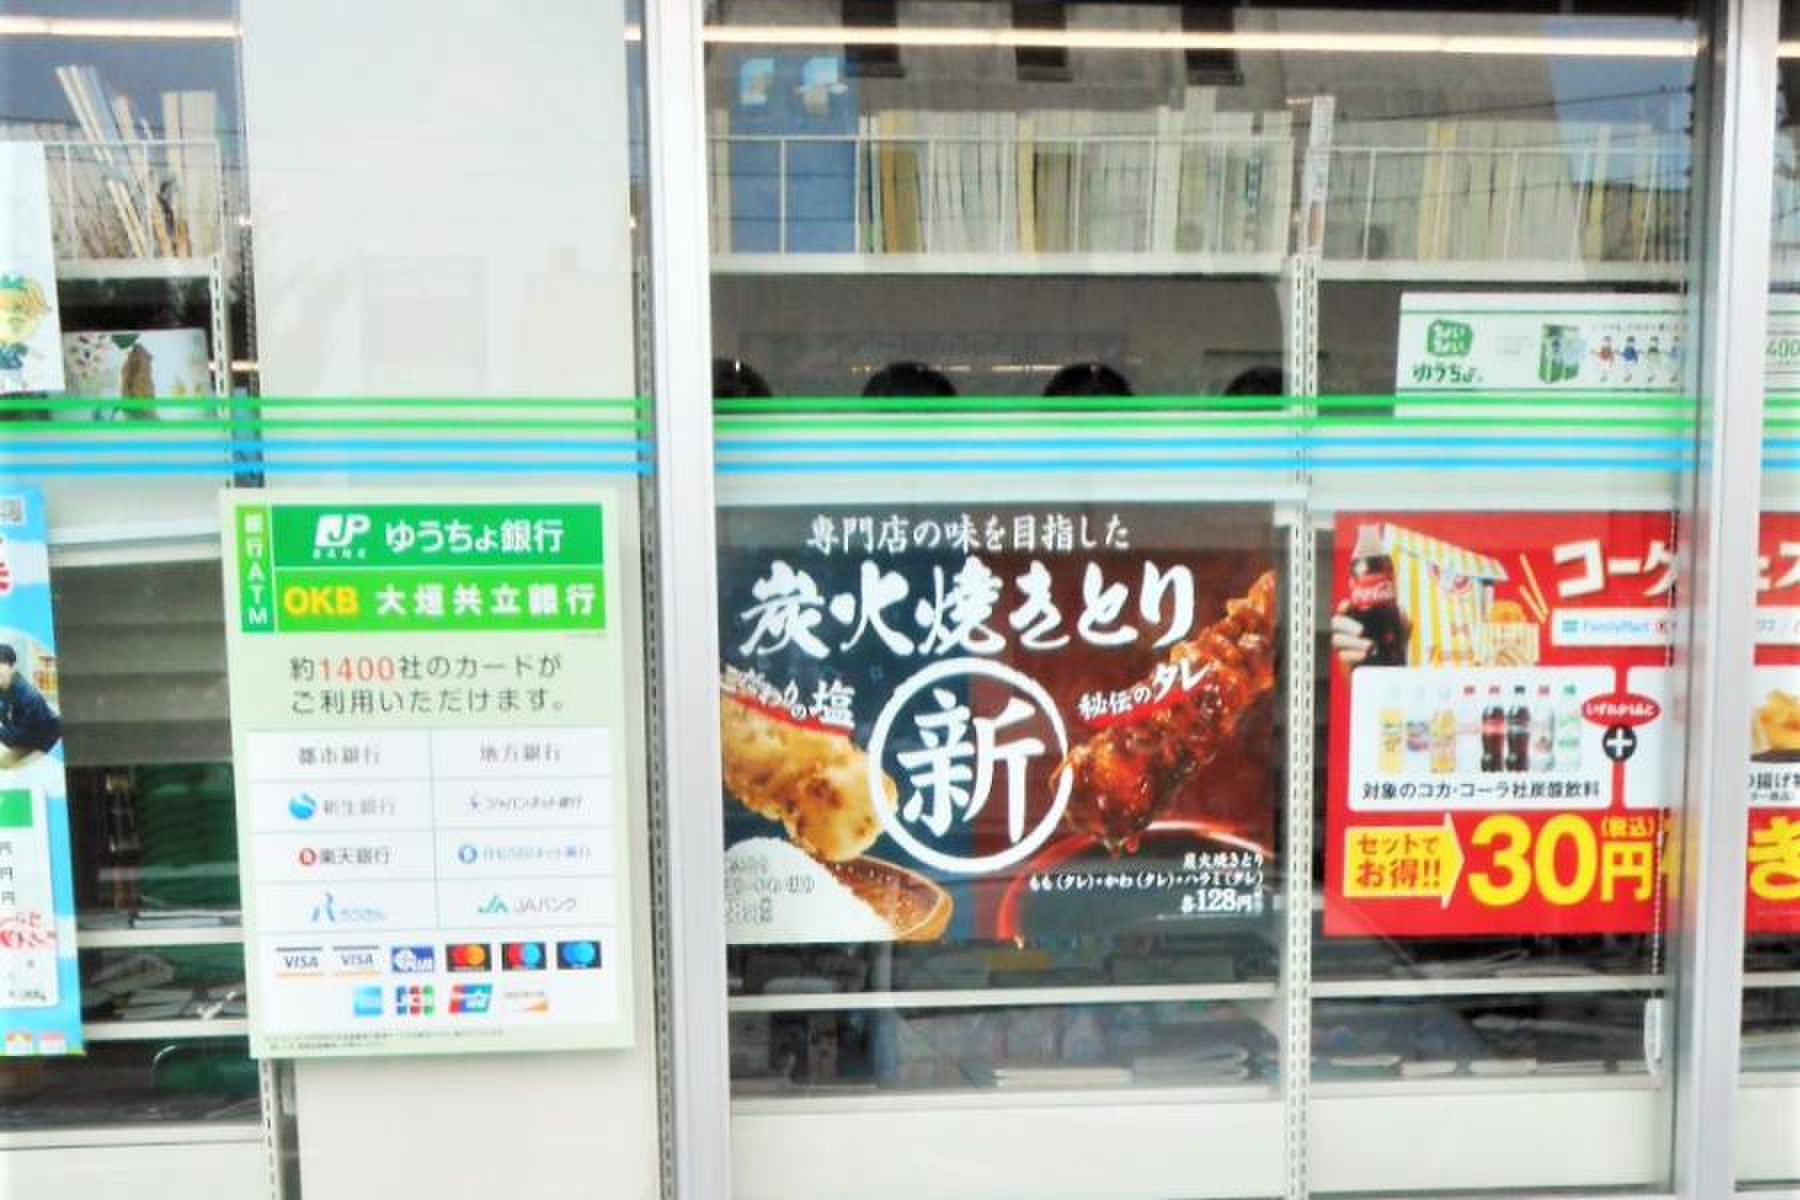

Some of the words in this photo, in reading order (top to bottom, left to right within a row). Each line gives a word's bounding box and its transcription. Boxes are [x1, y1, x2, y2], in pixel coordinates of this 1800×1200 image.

[385, 519, 564, 554] ゆうちょ銀行
[808, 514, 1130, 552] 専門店の味を目指した
[284, 586, 360, 616] OKB
[375, 583, 597, 616] 大垣共立銀行
[739, 555, 1197, 658] 炭火焼きとり
[289, 654, 562, 682] 約1400社のカードが
[291, 687, 565, 715] ご利用いただけます。
[1078, 657, 1217, 721] 秘伝のタレ
[896, 688, 1046, 845] 新
[1356, 832, 1440, 855] セットで
[1355, 859, 1440, 889] お得!!
[284, 956, 319, 968] VISA
[341, 953, 374, 966] VISA
